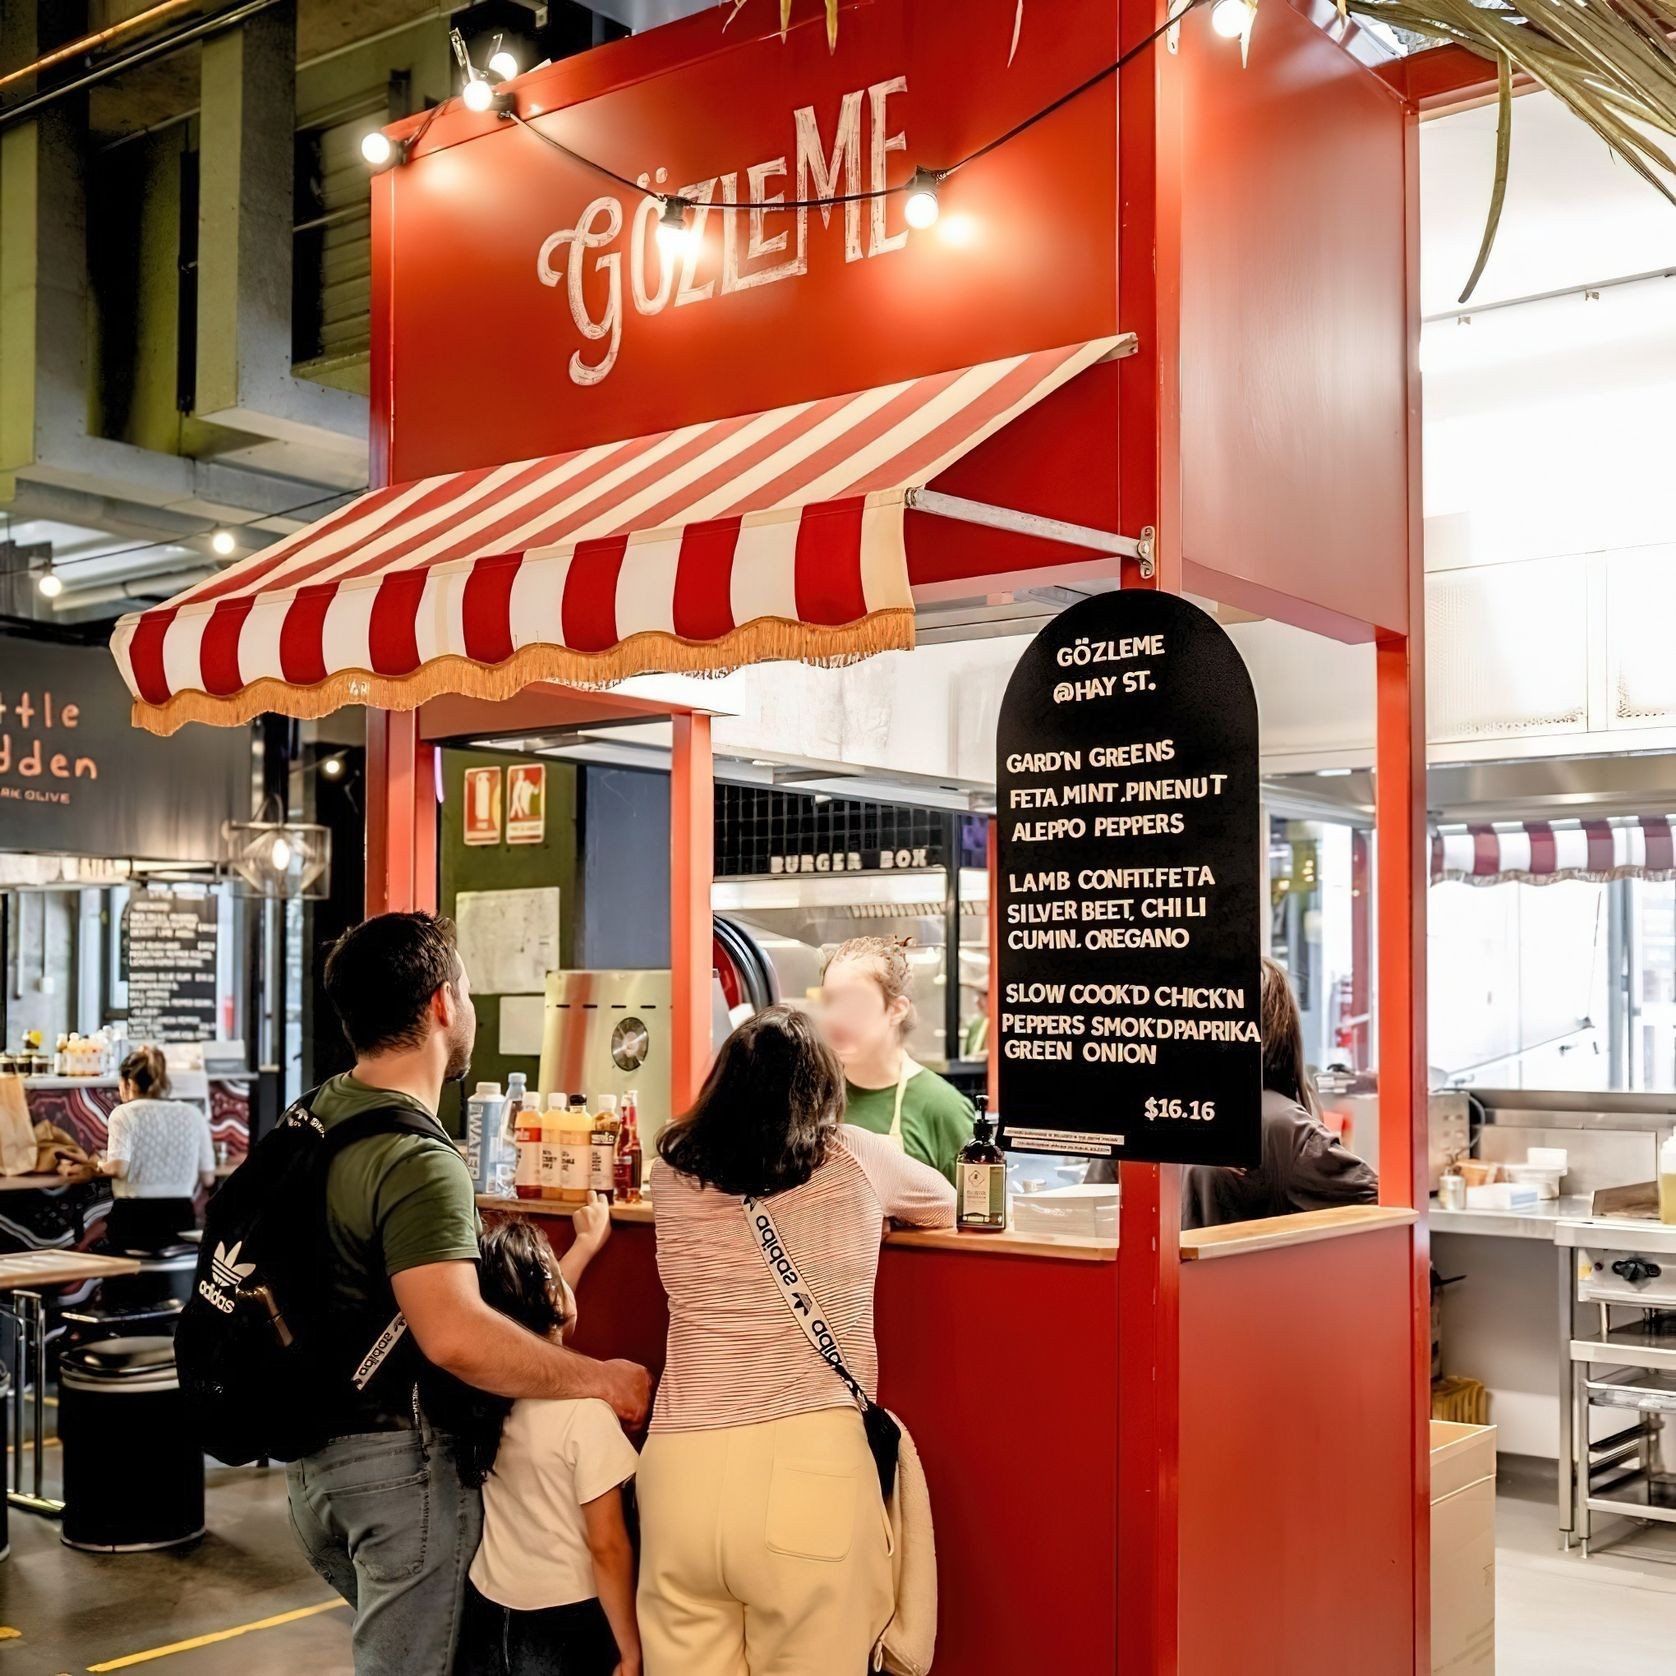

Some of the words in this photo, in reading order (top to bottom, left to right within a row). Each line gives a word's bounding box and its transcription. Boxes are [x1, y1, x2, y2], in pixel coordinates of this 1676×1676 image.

[1056, 634, 1166, 667] GÖZLEME
[1053, 675, 1118, 704] @HAY
[1122, 670, 1157, 693] ST.
[1006, 750, 1081, 774] GARD'N
[1088, 739, 1175, 769] GREENS
[24, 790, 71, 805] OLIVE
[1011, 817, 1086, 842] ALEPPO
[1094, 813, 1185, 837] PEPPERS
[770, 851, 862, 874] BURGER
[879, 848, 927, 869] BOX
[1009, 871, 1071, 893] LAMB
[1007, 900, 1078, 924] SILVER
[1081, 899, 1135, 922] BEET,
[1140, 896, 1207, 919] CHILI
[1084, 927, 1190, 951] OREGANO
[1005, 982, 1067, 1004] SLOW
[1069, 983, 1150, 1006] COOK'D
[1153, 986, 1245, 1010] CHICK'N
[1001, 1013, 1086, 1036] PEPPERS
[1004, 1039, 1073, 1061] GREEN
[1082, 1041, 1157, 1065] ONION
[1144, 1096, 1216, 1121] $16.16
[199, 1280, 235, 1313] adidas
